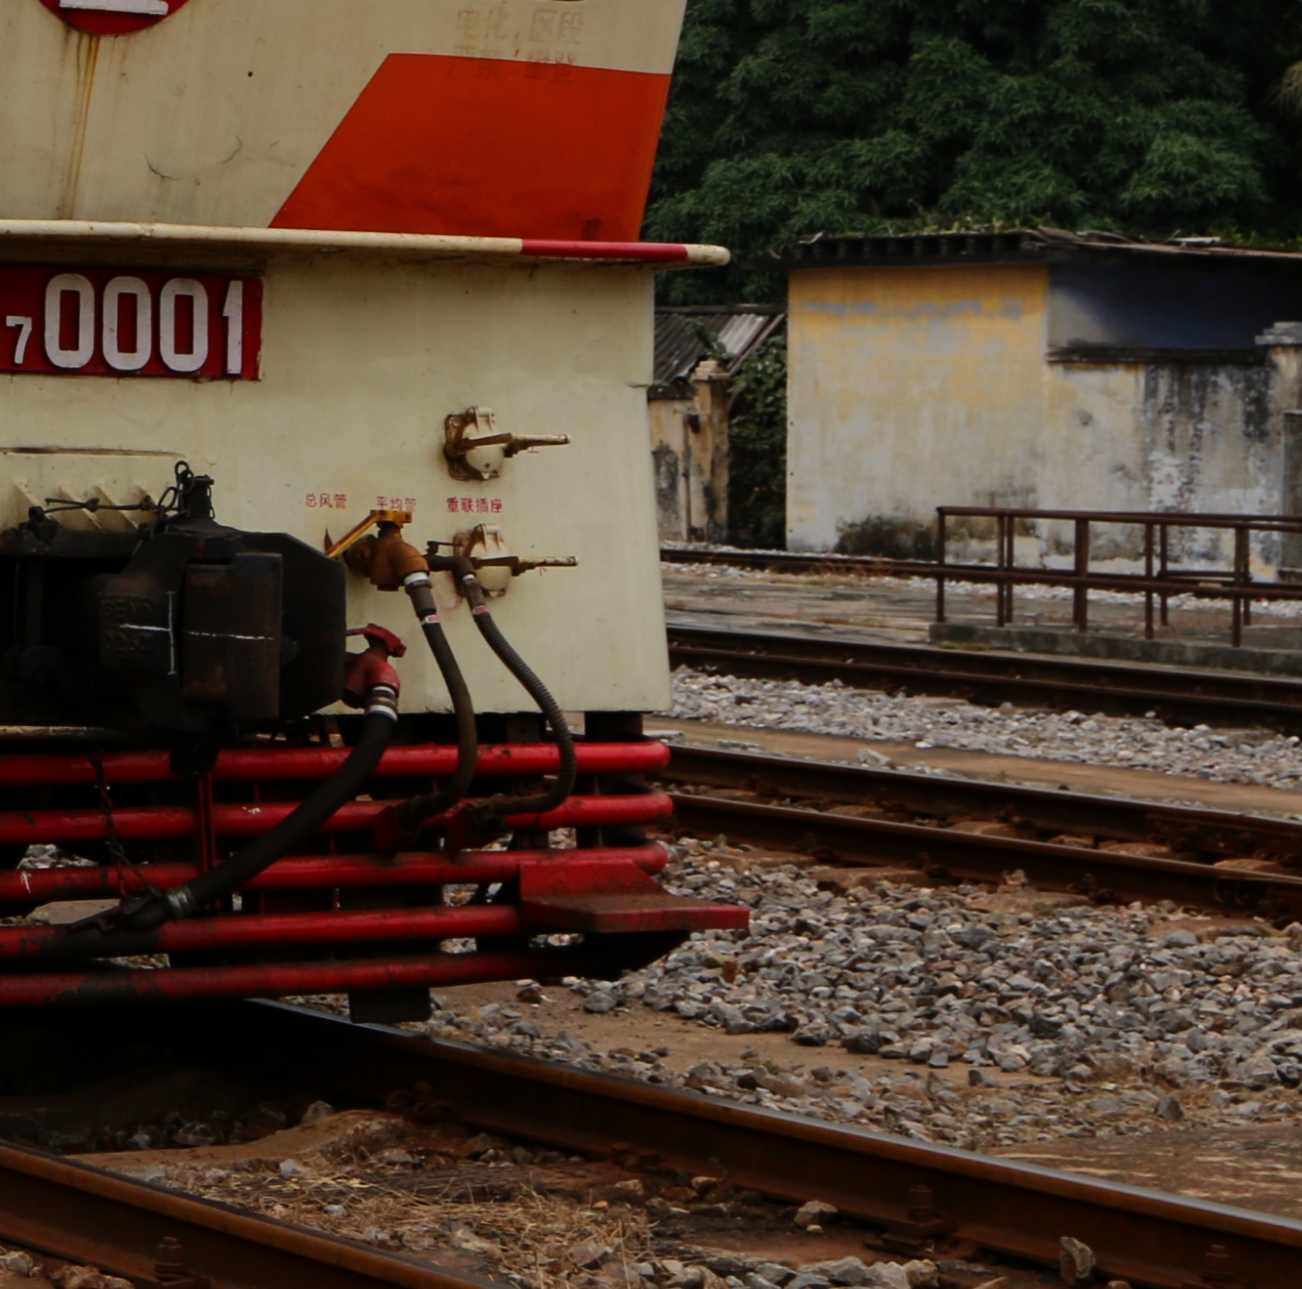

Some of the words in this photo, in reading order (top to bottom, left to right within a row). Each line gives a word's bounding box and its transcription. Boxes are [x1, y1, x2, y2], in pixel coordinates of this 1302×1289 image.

[305, 492, 347, 510] 总风管
[446, 496, 504, 513] 重联插座
